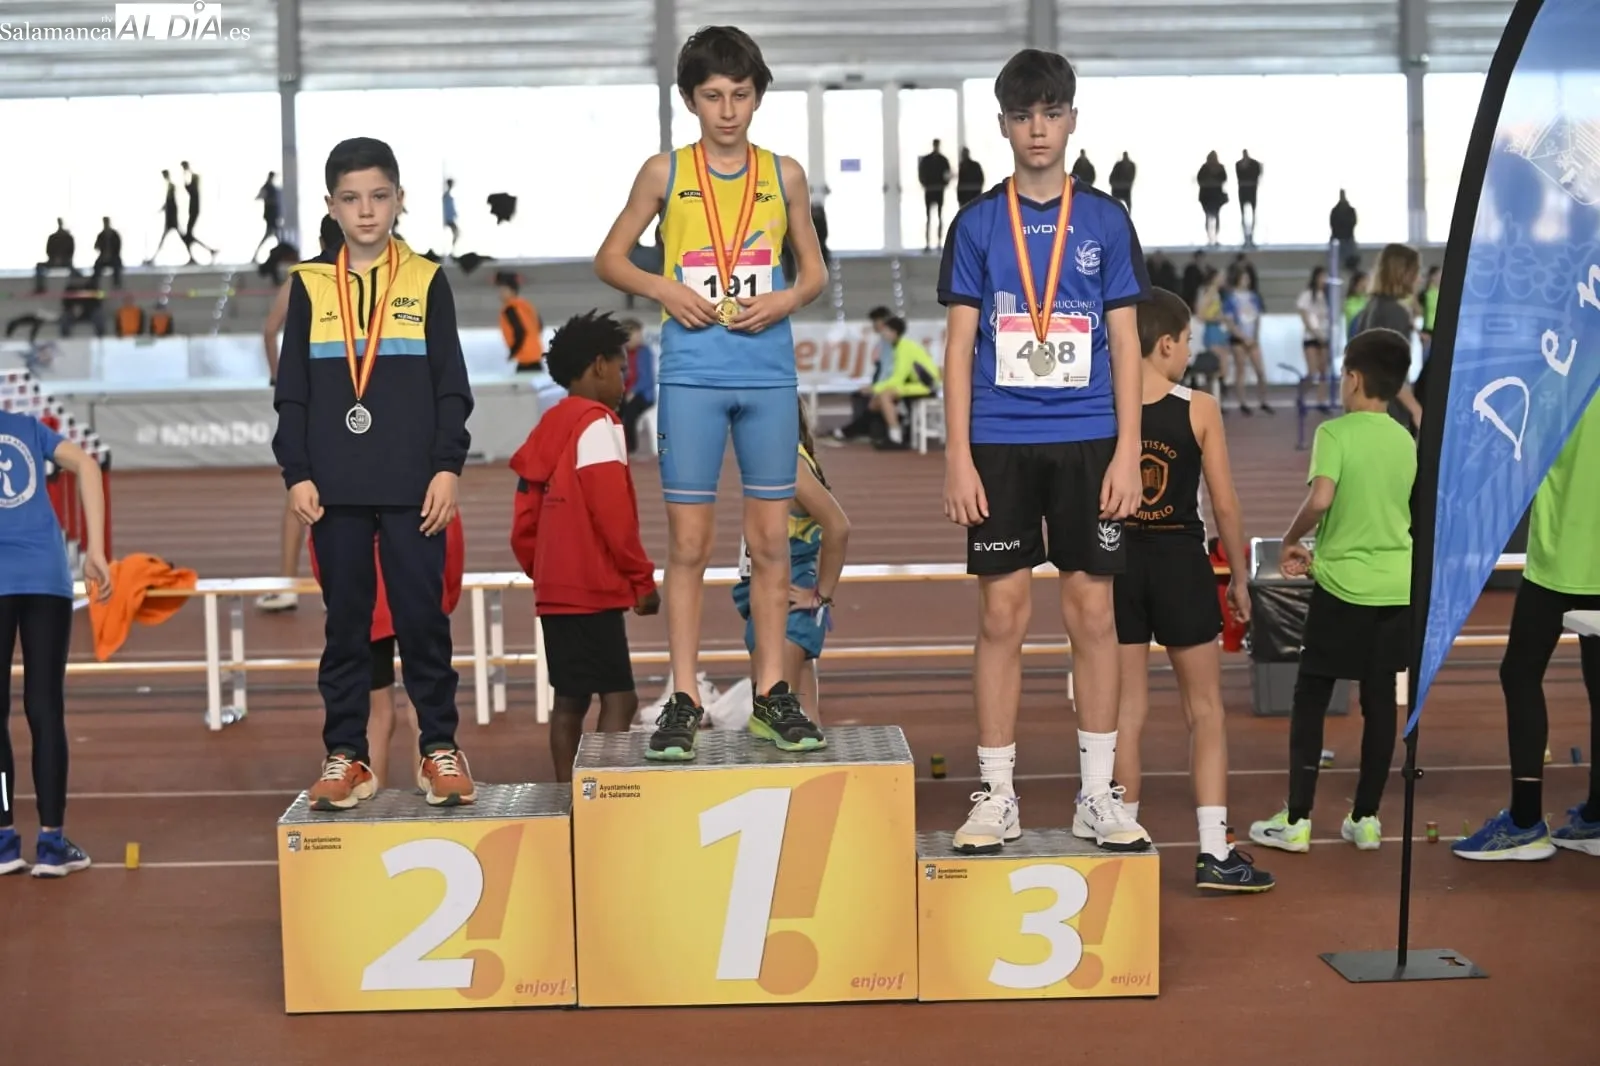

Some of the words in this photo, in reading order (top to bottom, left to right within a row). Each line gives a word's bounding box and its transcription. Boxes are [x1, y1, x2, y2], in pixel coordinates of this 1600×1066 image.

[704, 274, 757, 298] 191
[974, 540, 1020, 551] GIVOVA
[698, 787, 792, 980] 1
[360, 838, 484, 991] 2
[988, 863, 1089, 989] 3
[514, 978, 567, 997] enjoy!
[850, 972, 904, 992] enjoy!
